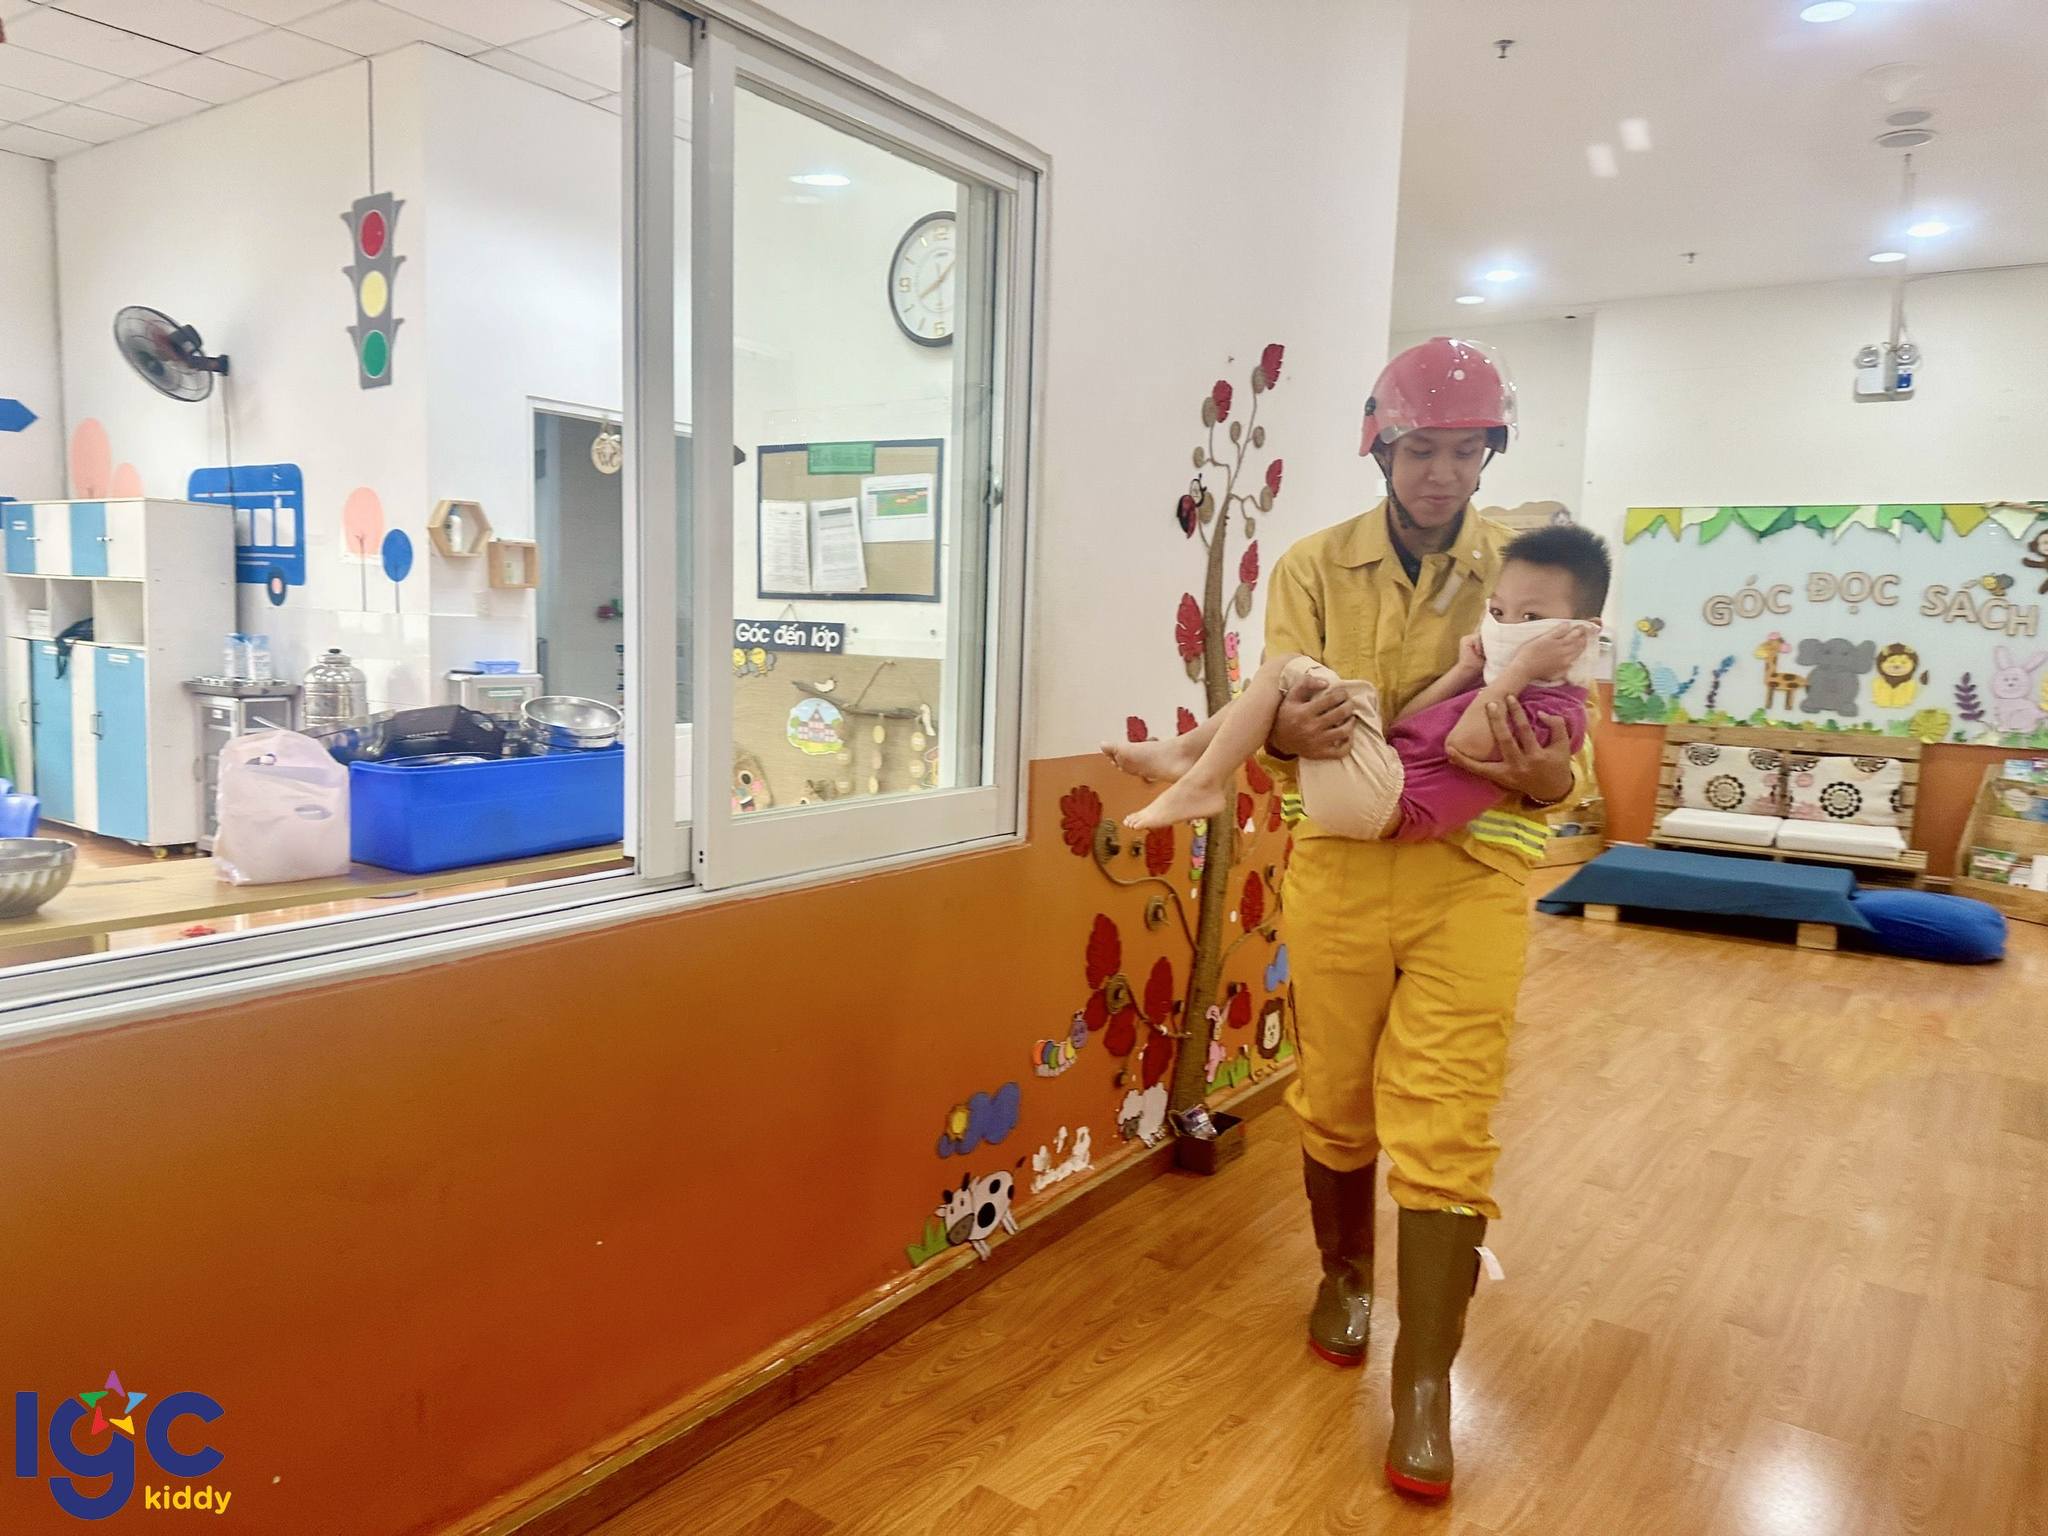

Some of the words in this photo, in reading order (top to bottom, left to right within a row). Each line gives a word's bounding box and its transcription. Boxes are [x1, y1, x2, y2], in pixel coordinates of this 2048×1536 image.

[899, 278, 911, 292] 9
[934, 321, 945, 335] 6
[1703, 574, 1793, 627] GÓC
[1807, 571, 1900, 615] ĐỌC
[1919, 578, 2040, 637] SÁCH
[735, 622, 771, 643] Góc
[773, 624, 807, 646] đến
[811, 625, 840, 652] lớp
